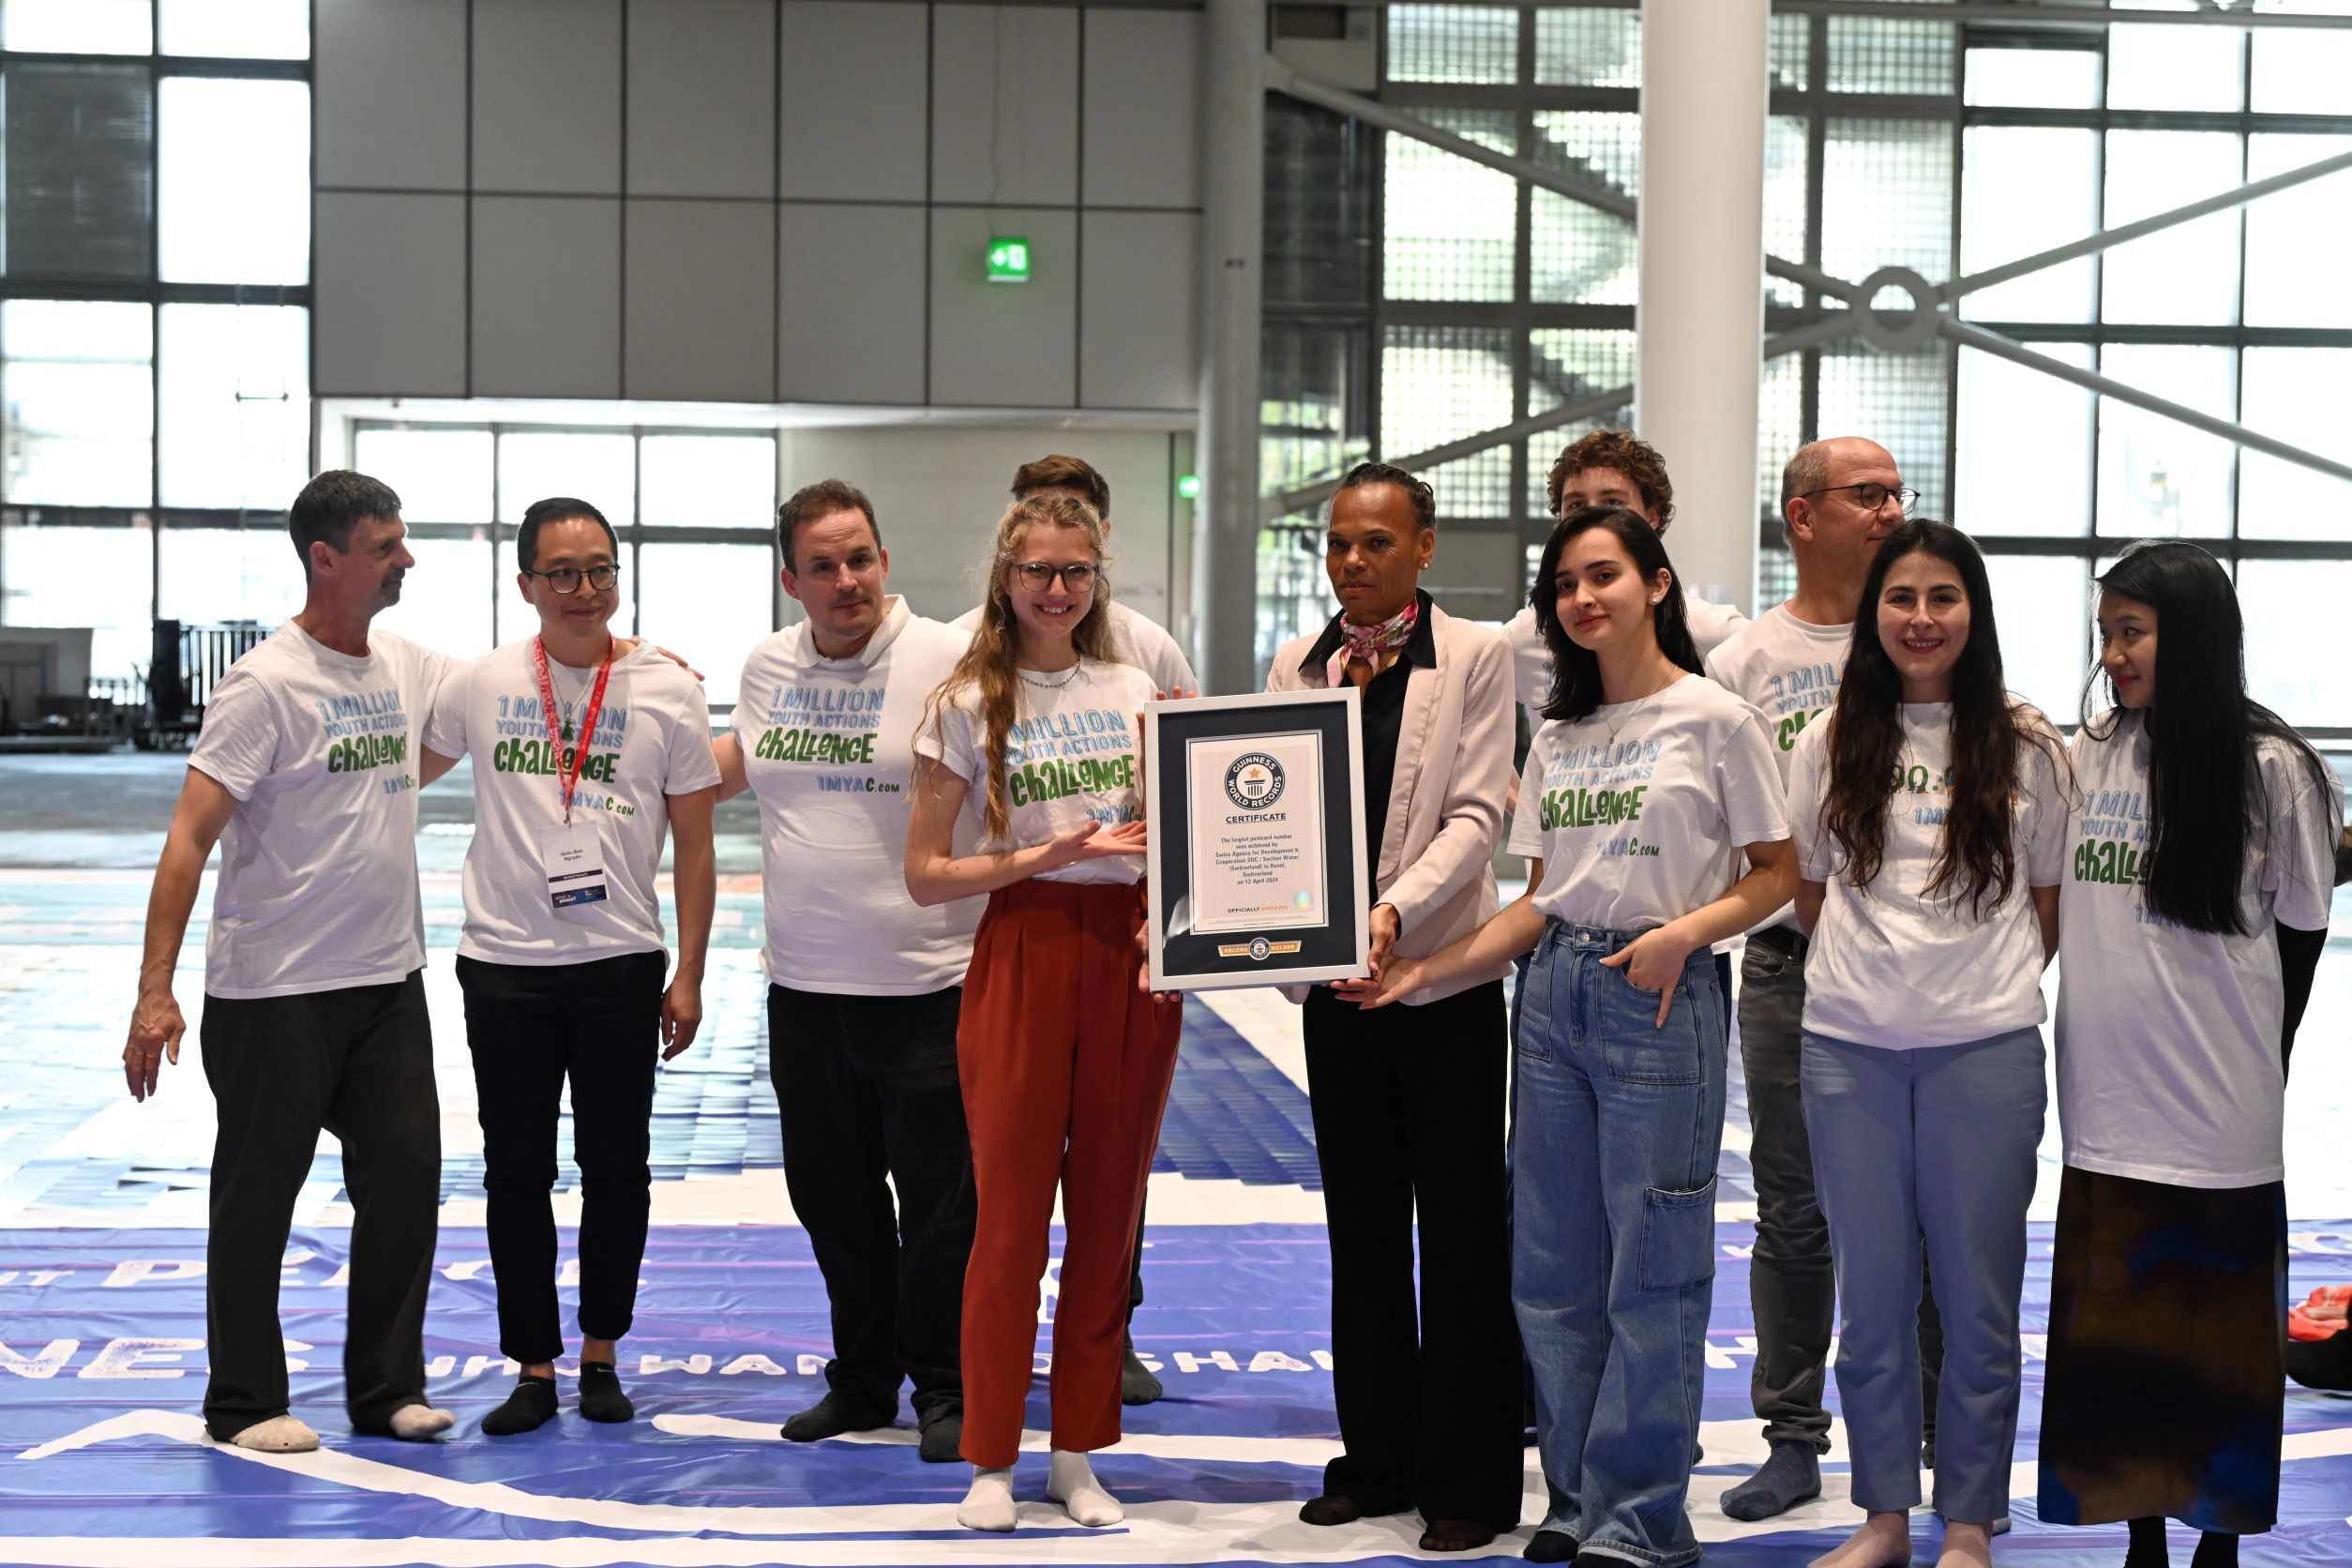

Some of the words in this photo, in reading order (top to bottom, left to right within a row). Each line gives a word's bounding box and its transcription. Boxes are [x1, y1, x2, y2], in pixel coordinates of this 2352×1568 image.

[1770, 675, 1786, 698] 1
[1787, 660, 1847, 694] MIL
[498, 695, 510, 718] 1
[772, 685, 782, 708] 1
[782, 686, 885, 712] MILLION
[1775, 689, 1833, 716] YOUTH
[324, 719, 369, 739] YOUTH
[496, 719, 549, 738] YOUTH
[767, 710, 810, 727] YOUTH
[813, 713, 882, 729] ACTIONS
[1008, 709, 1127, 745] MILLION
[1062, 734, 1133, 756] ACTIONS
[1559, 740, 1663, 770] MILLION
[1232, 756, 1276, 774] GUINNESS
[817, 775, 900, 793] 1MYAC.COM
[1228, 779, 1249, 807] WORLD
[1251, 776, 1282, 807] RECORDS
[2084, 790, 2096, 817] 1
[1226, 813, 1287, 823] CERTIFICATE
[2080, 818, 2129, 839] YOUTH
[1260, 848, 1293, 856] Development
